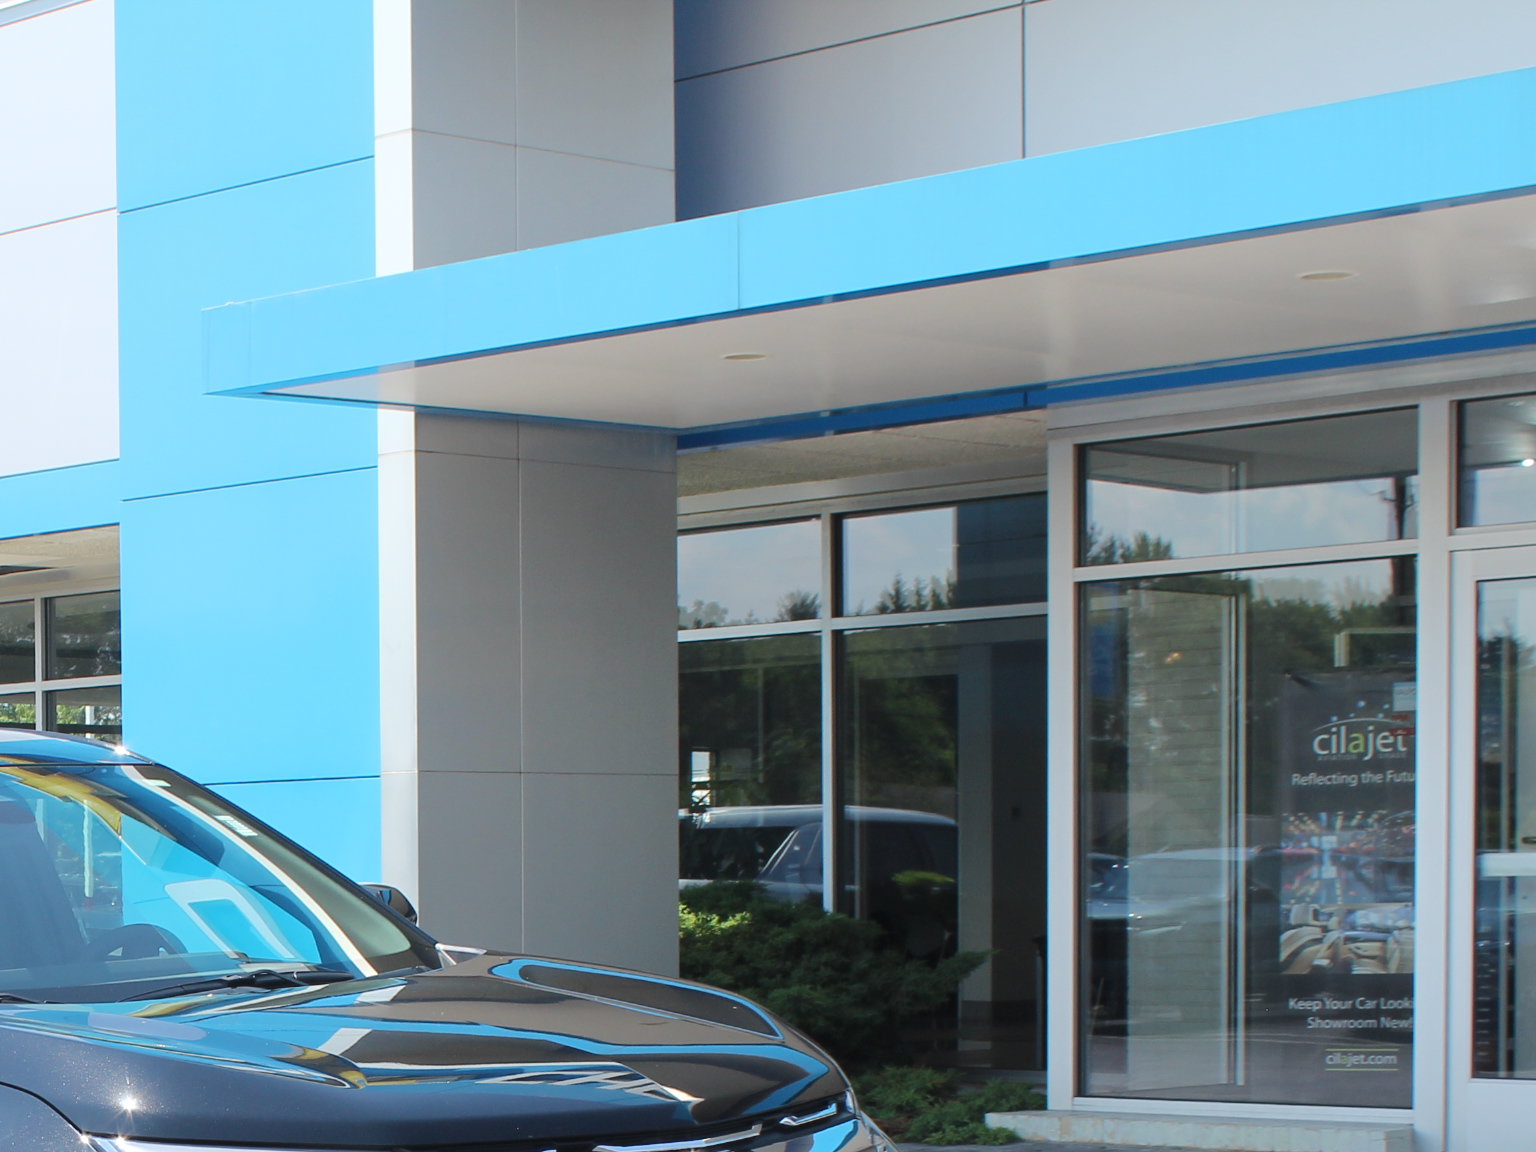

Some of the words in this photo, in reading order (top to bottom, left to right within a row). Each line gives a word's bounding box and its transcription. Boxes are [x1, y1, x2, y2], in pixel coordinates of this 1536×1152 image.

[1313, 725, 1408, 760] cilajet
[1291, 773, 1358, 787] Reflecting
[1361, 771, 1383, 783] the
[1288, 998, 1322, 1012] Keep
[1323, 998, 1353, 1010] Your
[1355, 997, 1378, 1009] Car
[1307, 1016, 1377, 1028] Showroom
[1325, 1052, 1397, 1067] cilajet.com
